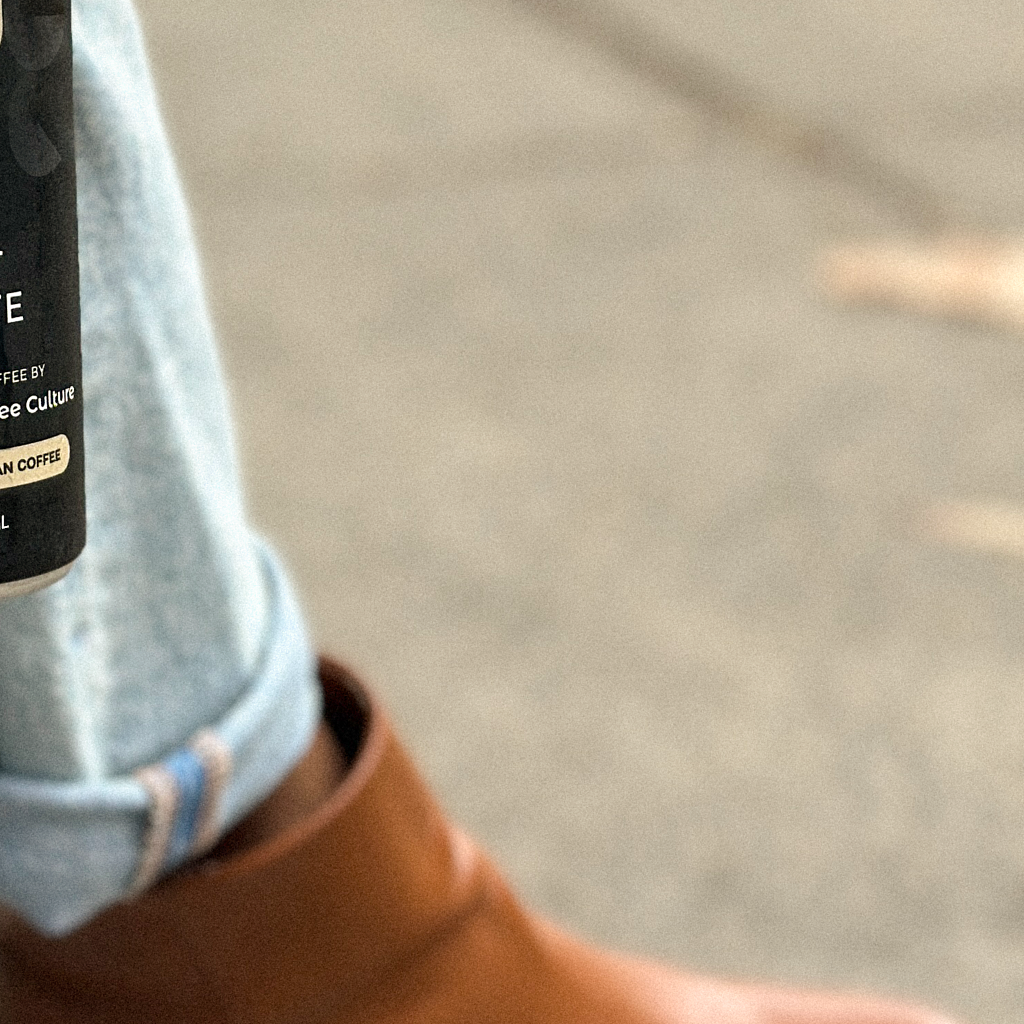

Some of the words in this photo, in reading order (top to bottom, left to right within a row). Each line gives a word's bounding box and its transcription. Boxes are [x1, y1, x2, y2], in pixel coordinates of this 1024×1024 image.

[30, 363, 46, 380] BY
[25, 384, 75, 414] Culture
[17, 448, 61, 472] COFFEE
